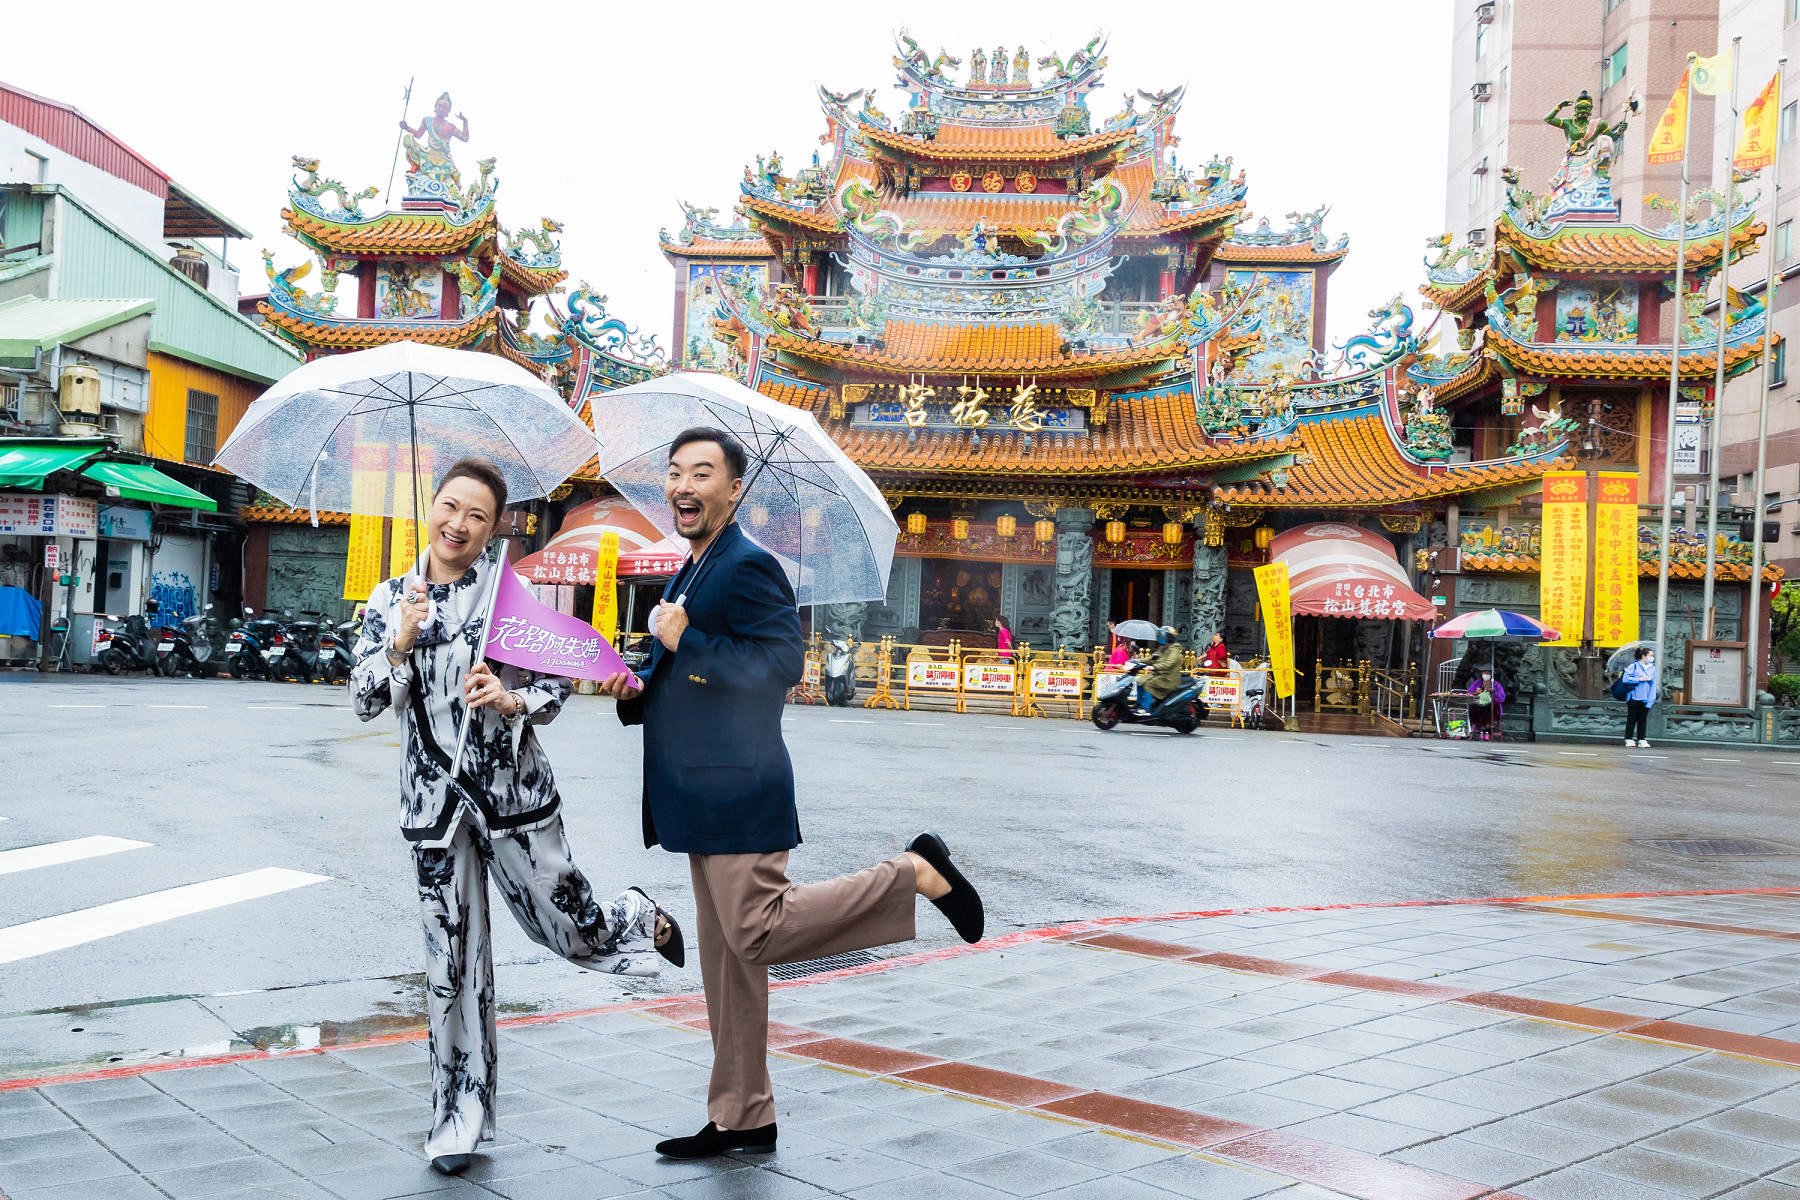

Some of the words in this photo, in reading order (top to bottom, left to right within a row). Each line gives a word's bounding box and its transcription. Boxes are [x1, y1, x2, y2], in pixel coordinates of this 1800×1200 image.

[1354, 584, 1395, 599] 台北市
[1324, 597, 1407, 616] 松山慈祐宮
[487, 616, 601, 663] 花路阿朱媽
